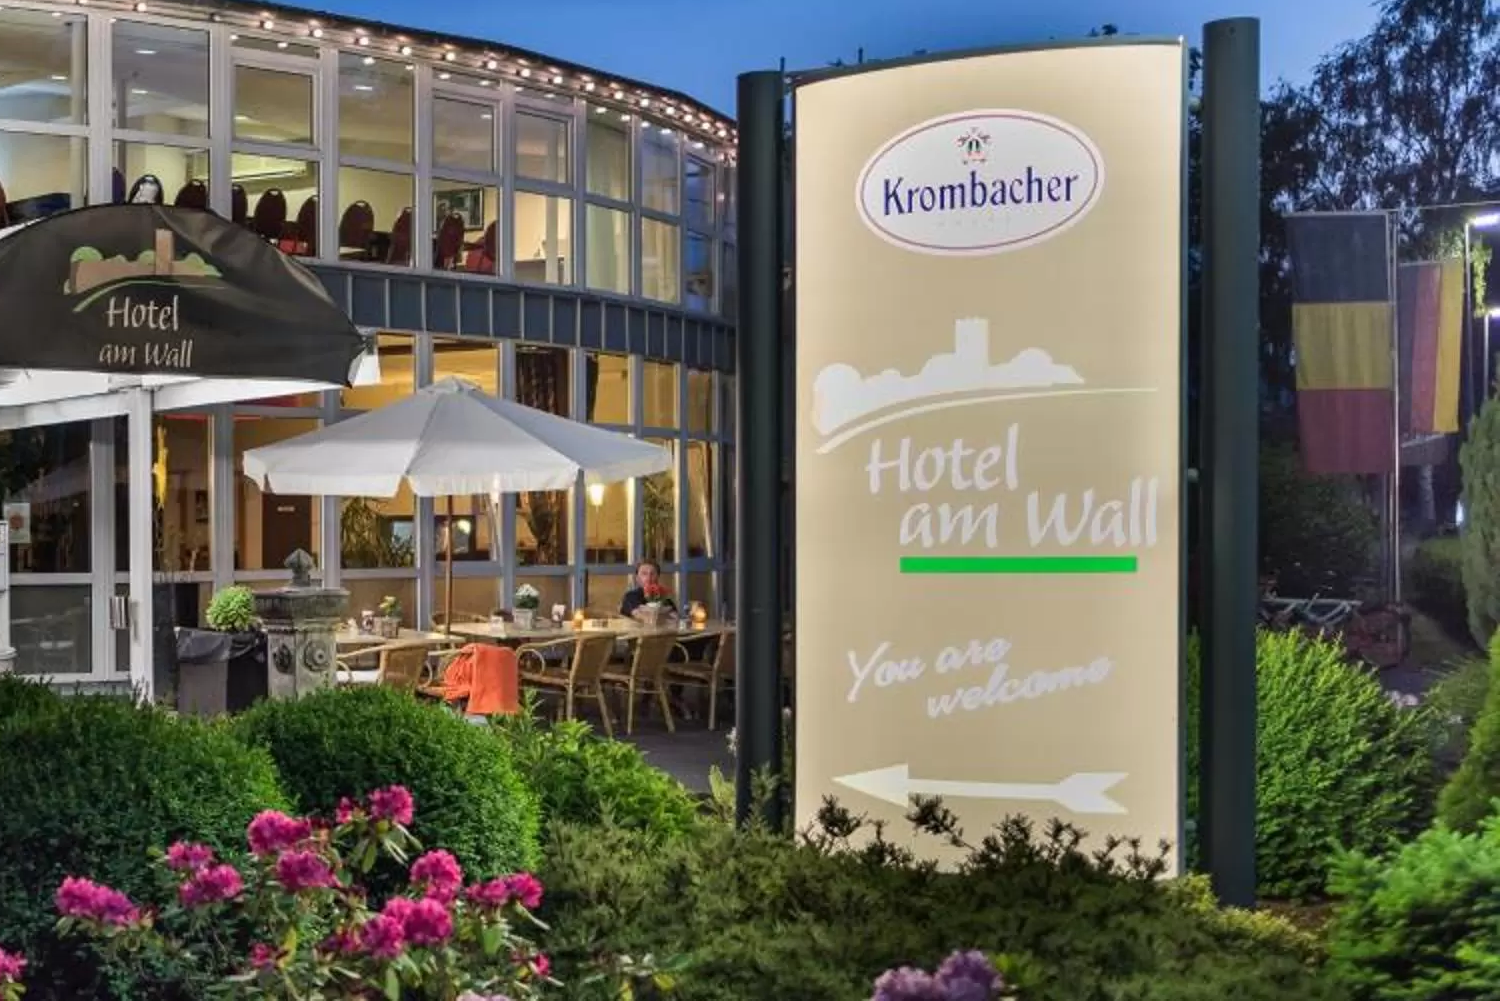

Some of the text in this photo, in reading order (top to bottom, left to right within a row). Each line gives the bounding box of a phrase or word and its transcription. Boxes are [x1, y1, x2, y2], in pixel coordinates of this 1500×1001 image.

[883, 166, 1079, 216] Krombacher
[105, 294, 179, 331] Hotel
[99, 339, 193, 368] am Wall
[866, 423, 1019, 493] Hotel
[901, 477, 1158, 548] am Wall
[847, 636, 1011, 703] You are
[927, 662, 1112, 718] welcome
